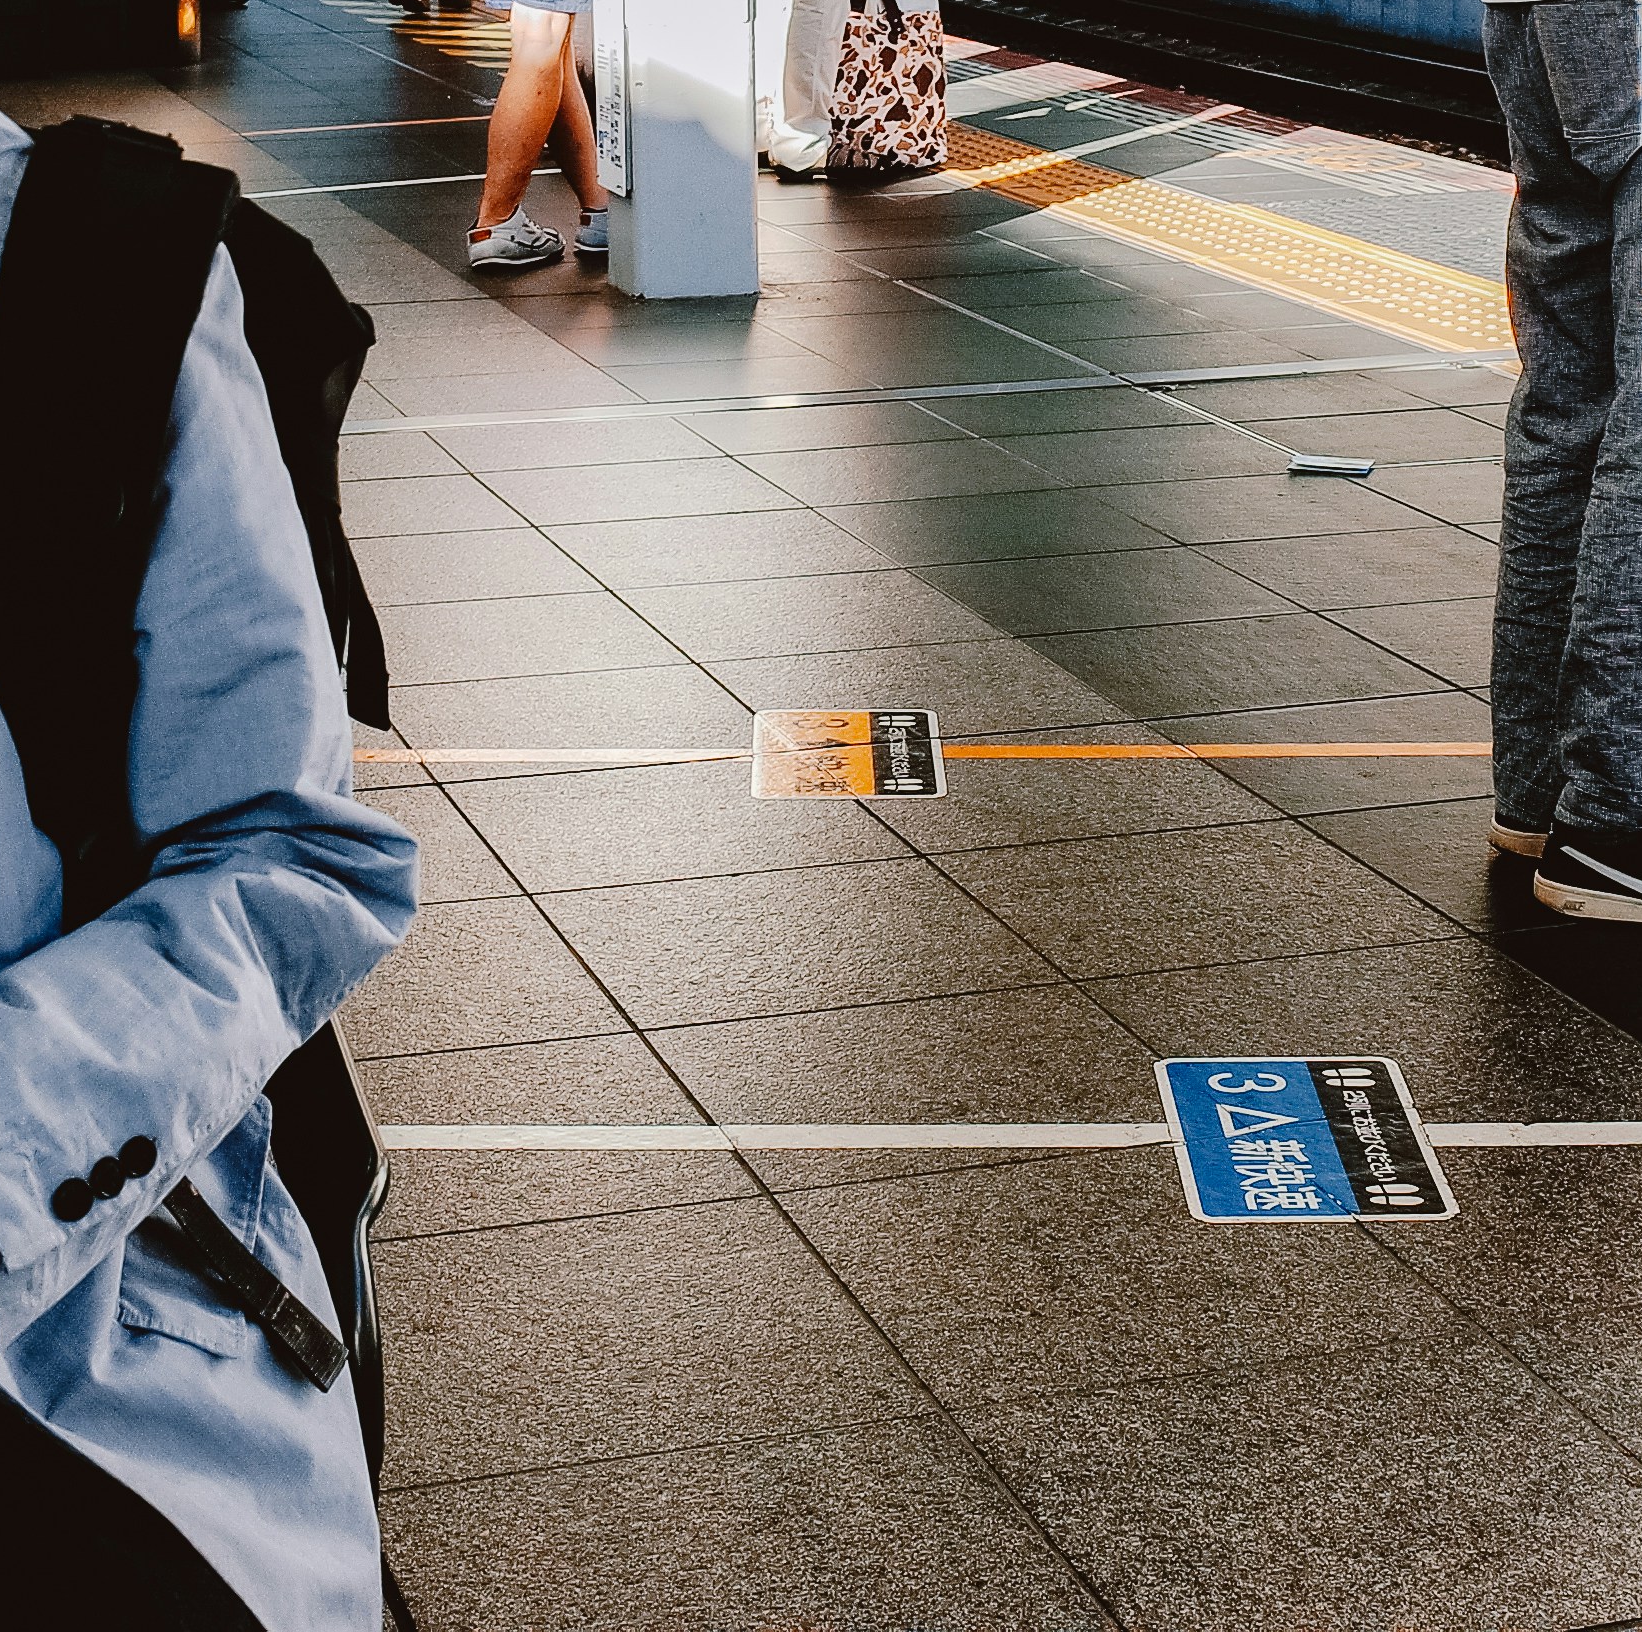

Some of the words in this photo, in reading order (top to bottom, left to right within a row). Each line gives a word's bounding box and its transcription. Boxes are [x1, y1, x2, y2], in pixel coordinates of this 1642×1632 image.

[1206, 1072, 1287, 1094] 3
[1227, 1138, 1343, 1211] 新快速
